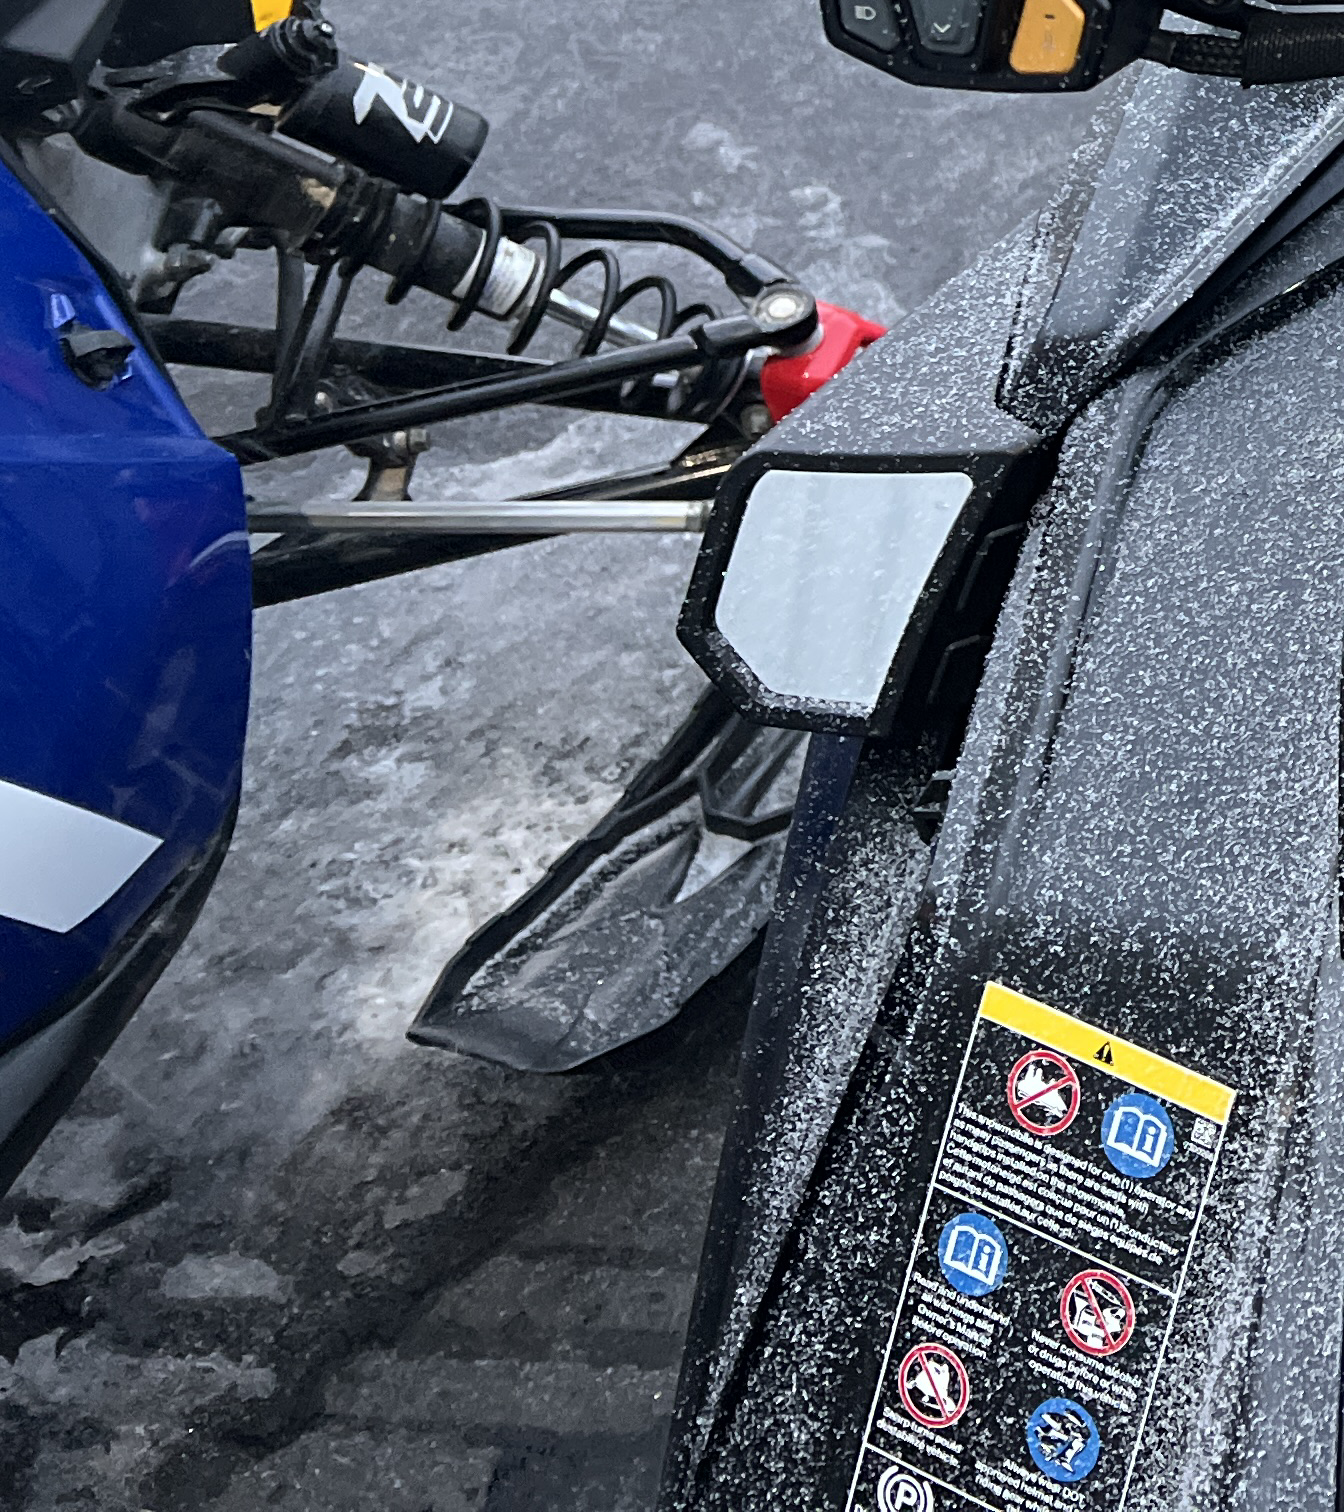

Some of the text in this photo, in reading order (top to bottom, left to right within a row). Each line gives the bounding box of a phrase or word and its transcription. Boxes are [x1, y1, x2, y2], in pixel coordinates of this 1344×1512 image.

[946, 1142, 973, 1161] Cette
[950, 1129, 996, 1158] handgrips
[996, 1150, 1037, 1176] installed
[958, 1102, 978, 1121] This
[977, 1114, 1034, 1146] snowmobile
[1043, 1144, 1088, 1170] designed
[1102, 1171, 1121, 1186] one
[1134, 1184, 1176, 1210] operator
[965, 1124, 992, 1142] many
[991, 1136, 1046, 1170] passengers
[1058, 1164, 1084, 1184] there
[1100, 1185, 1127, 1203] seats
[913, 1271, 939, 1291] Read
[956, 1293, 1010, 1326] understand
[933, 1298, 974, 1324] warnings
[1031, 1328, 1142, 1387] Never consume alcohol
[1039, 1350, 1066, 1369] drugs
[1068, 1360, 1099, 1384] before
[1028, 1360, 1076, 1389] operating
[883, 1406, 911, 1428] Sharp
[876, 1418, 925, 1450] destabilize
[974, 1460, 1020, 1489] approved
[1002, 1458, 1040, 1483] Always
